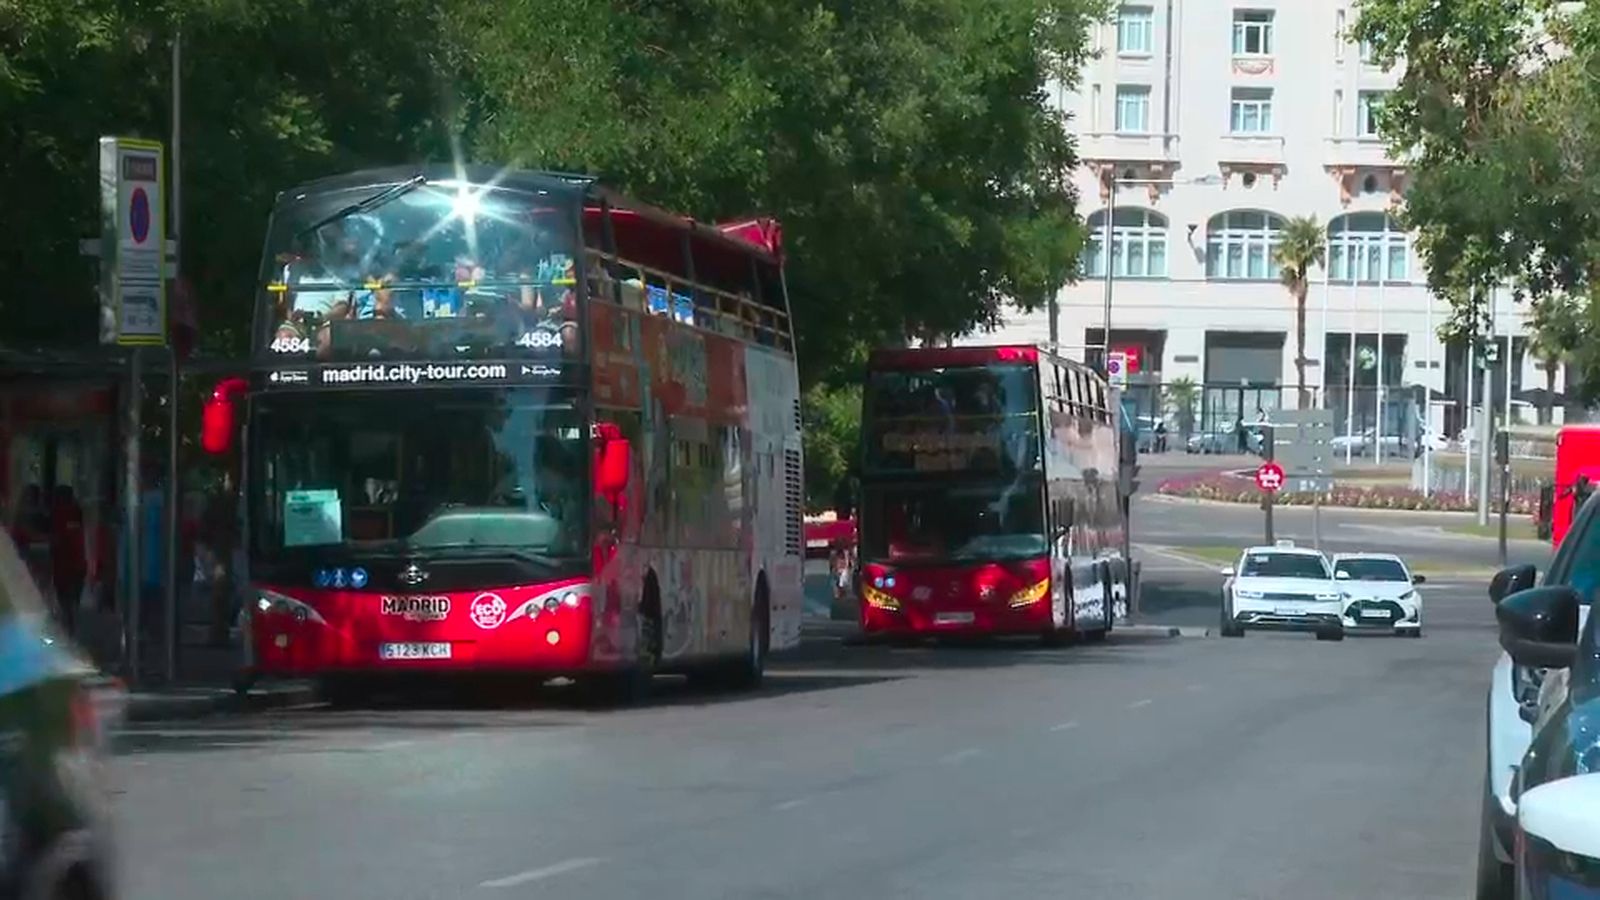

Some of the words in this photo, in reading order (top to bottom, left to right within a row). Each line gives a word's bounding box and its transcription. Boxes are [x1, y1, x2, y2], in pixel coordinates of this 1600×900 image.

[271, 337, 310, 353] 4584
[520, 332, 562, 348] 4584
[323, 363, 506, 384] madrid.city-tour.com
[382, 597, 450, 613] MADRID
[476, 603, 502, 616] ECO
[385, 643, 420, 657] 5123
